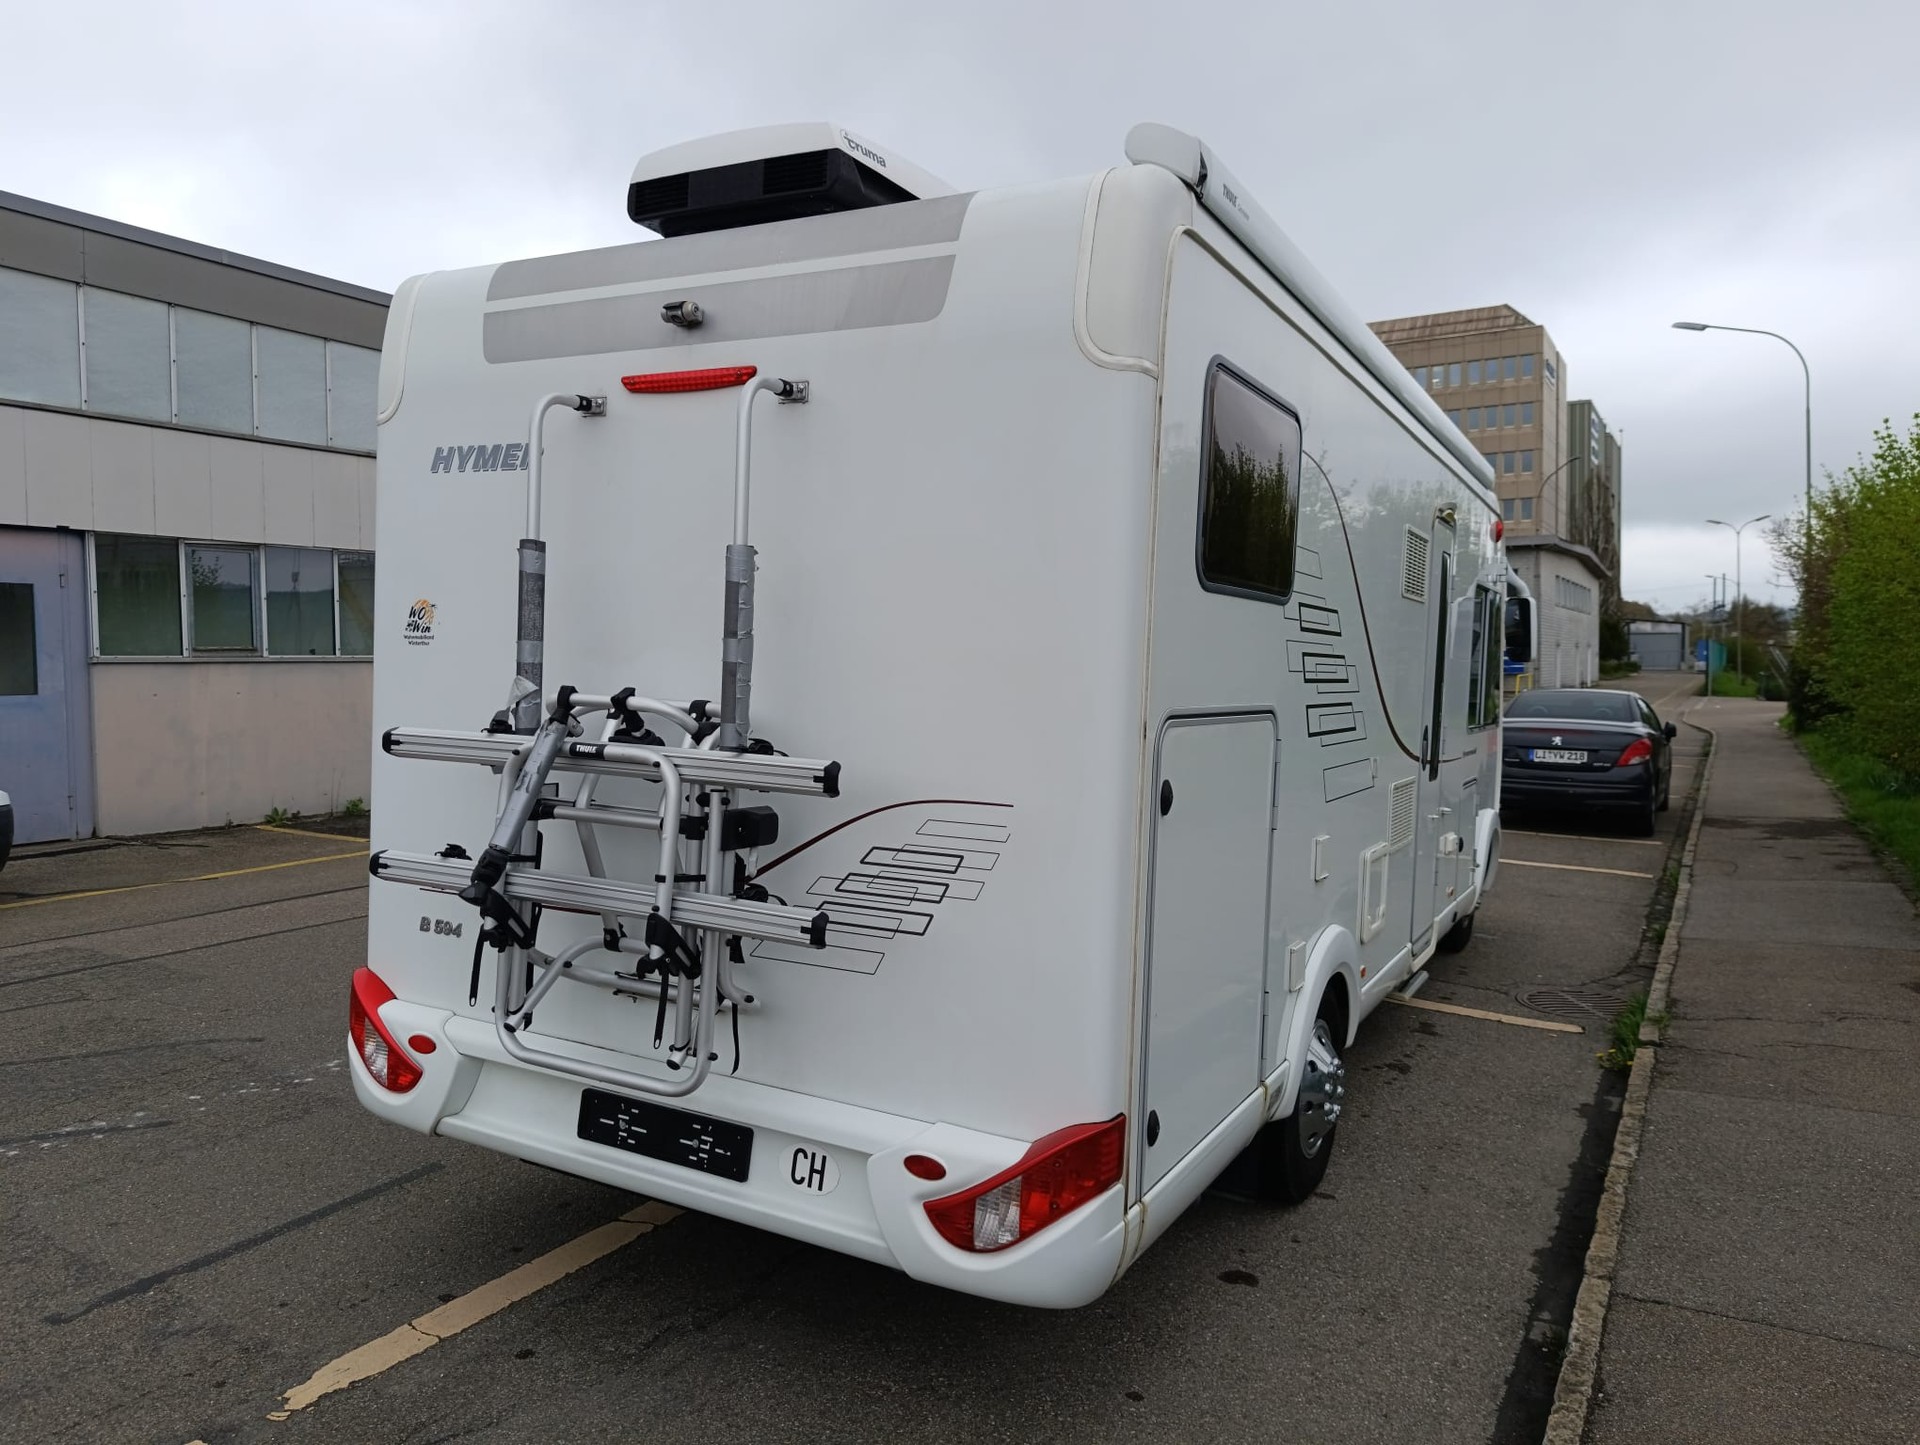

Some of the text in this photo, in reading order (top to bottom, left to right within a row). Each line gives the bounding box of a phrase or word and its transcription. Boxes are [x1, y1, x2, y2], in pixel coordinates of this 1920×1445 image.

[843, 131, 887, 168] truma
[576, 744, 598, 754] THULE
[1567, 752, 1585, 761] 218
[419, 916, 463, 938] B 594
[790, 1147, 827, 1192] CH
